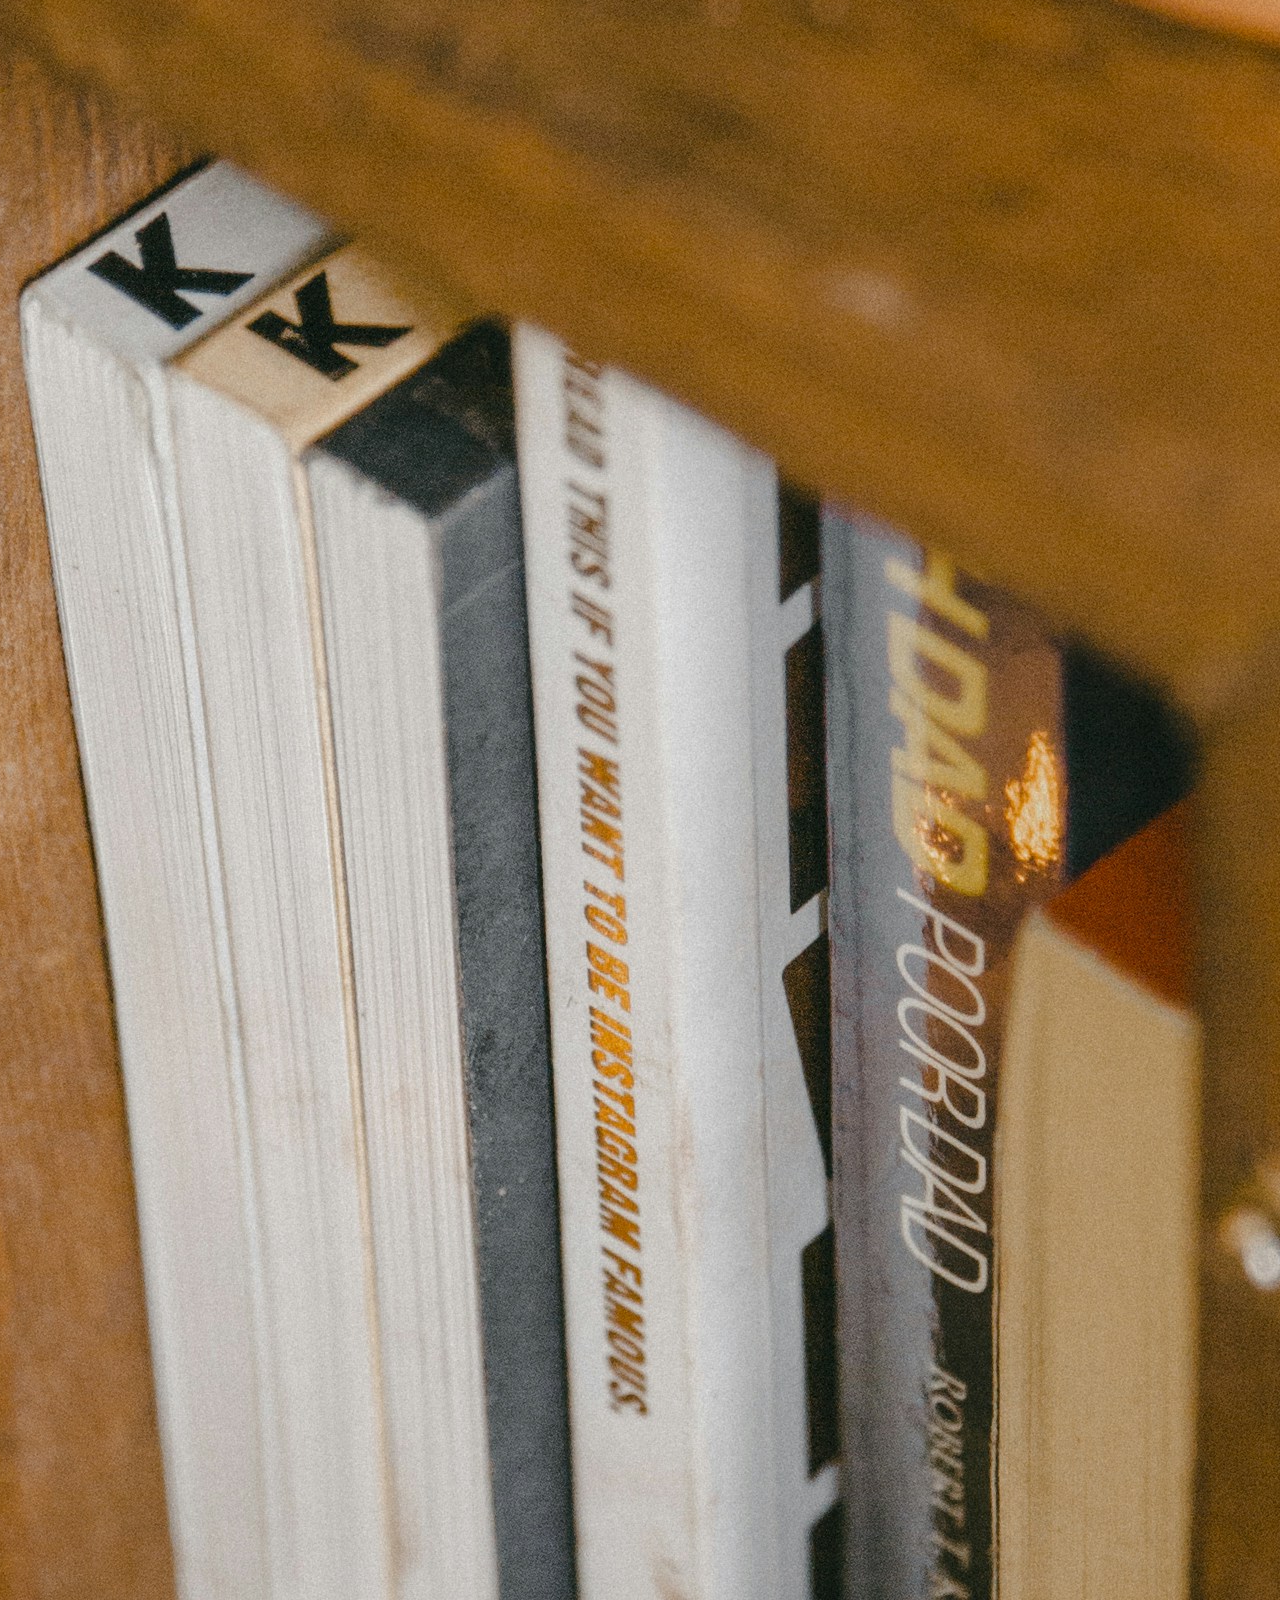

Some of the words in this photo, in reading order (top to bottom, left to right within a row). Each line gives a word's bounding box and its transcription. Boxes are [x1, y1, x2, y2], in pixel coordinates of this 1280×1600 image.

[86, 211, 255, 331] K
[246, 270, 414, 382] K
[567, 478, 612, 590] THIS
[572, 590, 613, 647] IF
[574, 650, 618, 744] YOU
[885, 610, 990, 897] DAD
[579, 747, 623, 880] WANT
[583, 879, 628, 946] TO
[586, 940, 631, 1013] BE
[894, 885, 988, 1128] POOR
[589, 1005, 640, 1251] INSTAGRAM
[898, 1100, 990, 1296] DAD
